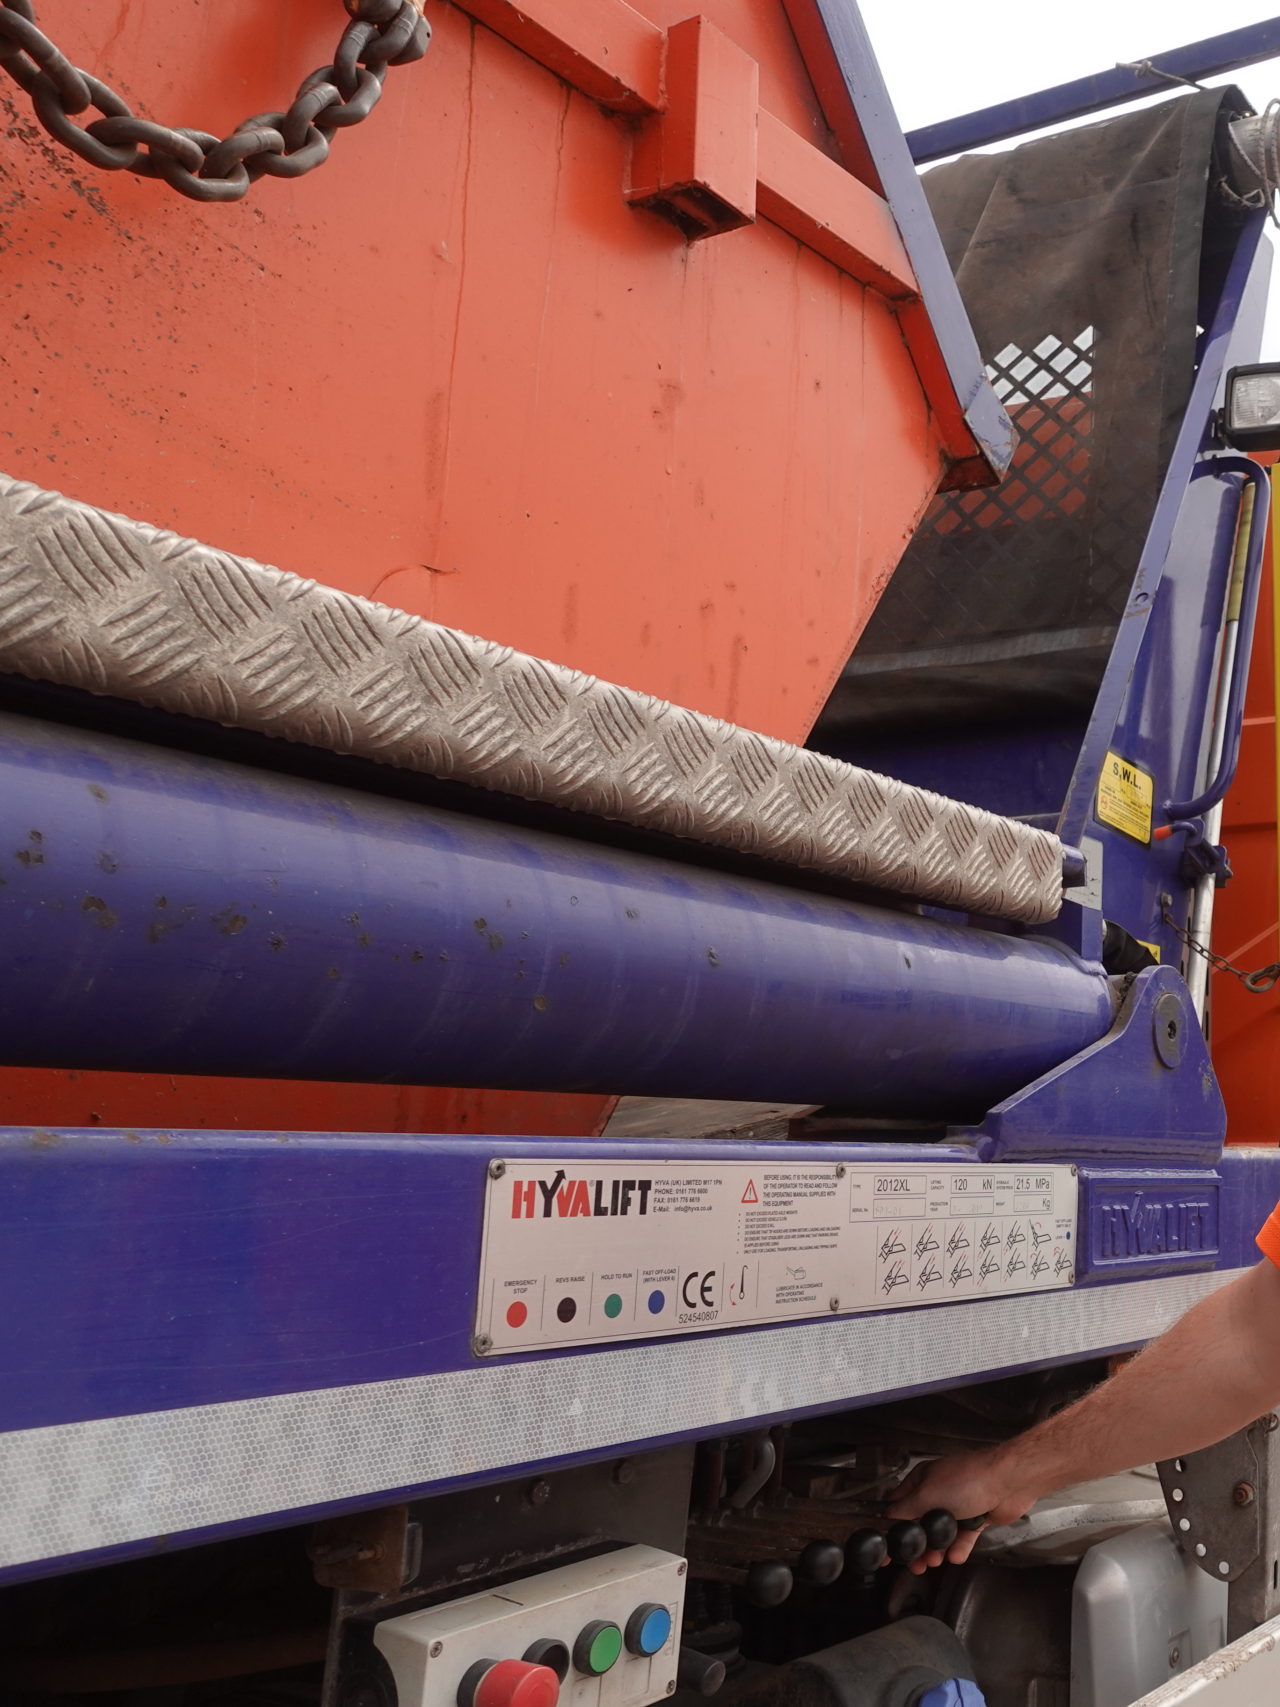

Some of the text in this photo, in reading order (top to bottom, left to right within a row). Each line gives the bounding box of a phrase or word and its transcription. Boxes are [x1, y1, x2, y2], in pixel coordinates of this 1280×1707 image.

[1112, 761, 1142, 790] S.W.L.
[876, 1178, 911, 1192] 2012XL
[954, 1178, 968, 1191] 120
[982, 1178, 993, 1191] kN
[1016, 1177, 1031, 1190] 21.5
[1035, 1177, 1050, 1190] MPa
[511, 1170, 652, 1219] HYVALIFT
[1042, 1198, 1051, 1211] Kg
[555, 1275, 586, 1284] REVS RAISE
[600, 1273, 615, 1281] HOLD
[622, 1272, 633, 1280] RUN
[642, 1269, 654, 1277] FAST
[656, 1275, 670, 1283] LEVER
[503, 1279, 538, 1287] EMERGENCY
[512, 1287, 529, 1295] STOP
[678, 1310, 719, 1324] 524540807
